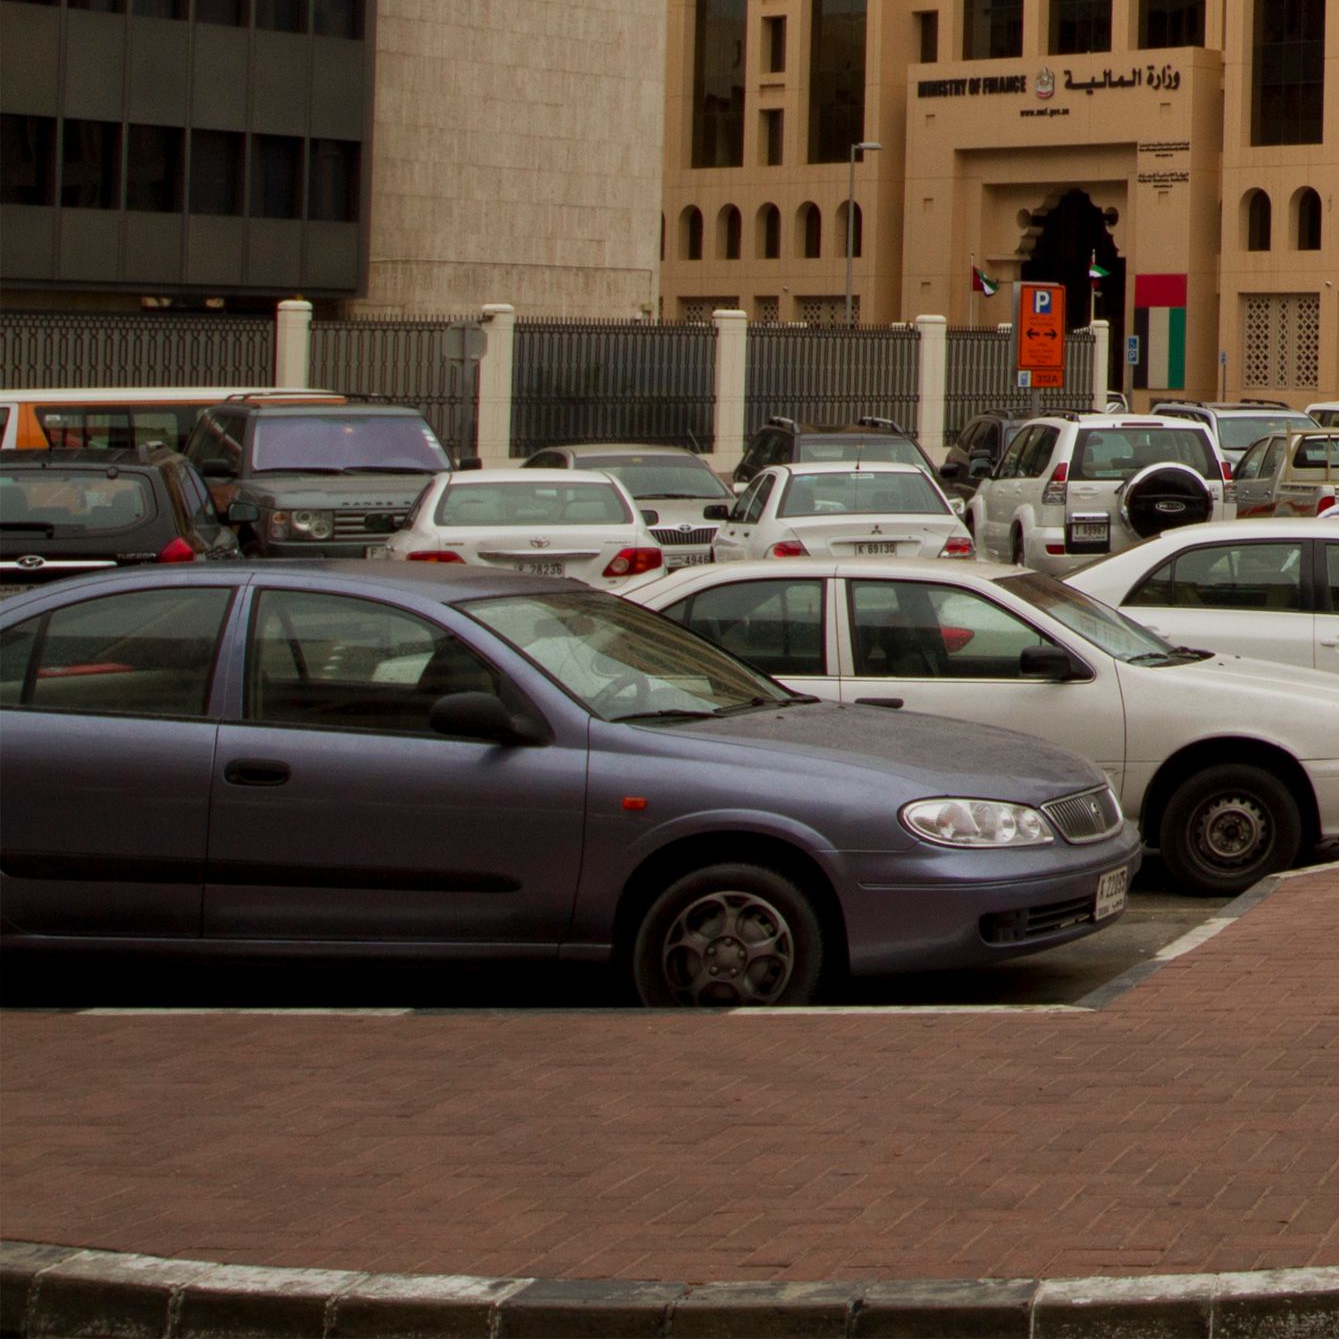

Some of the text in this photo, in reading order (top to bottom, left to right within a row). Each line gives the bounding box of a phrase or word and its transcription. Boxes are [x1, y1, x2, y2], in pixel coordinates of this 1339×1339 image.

[917, 74, 1026, 98] MINISTRY OF FINANCE
[1063, 64, 1181, 95] وزارة المالية
[1035, 290, 1051, 314] P
